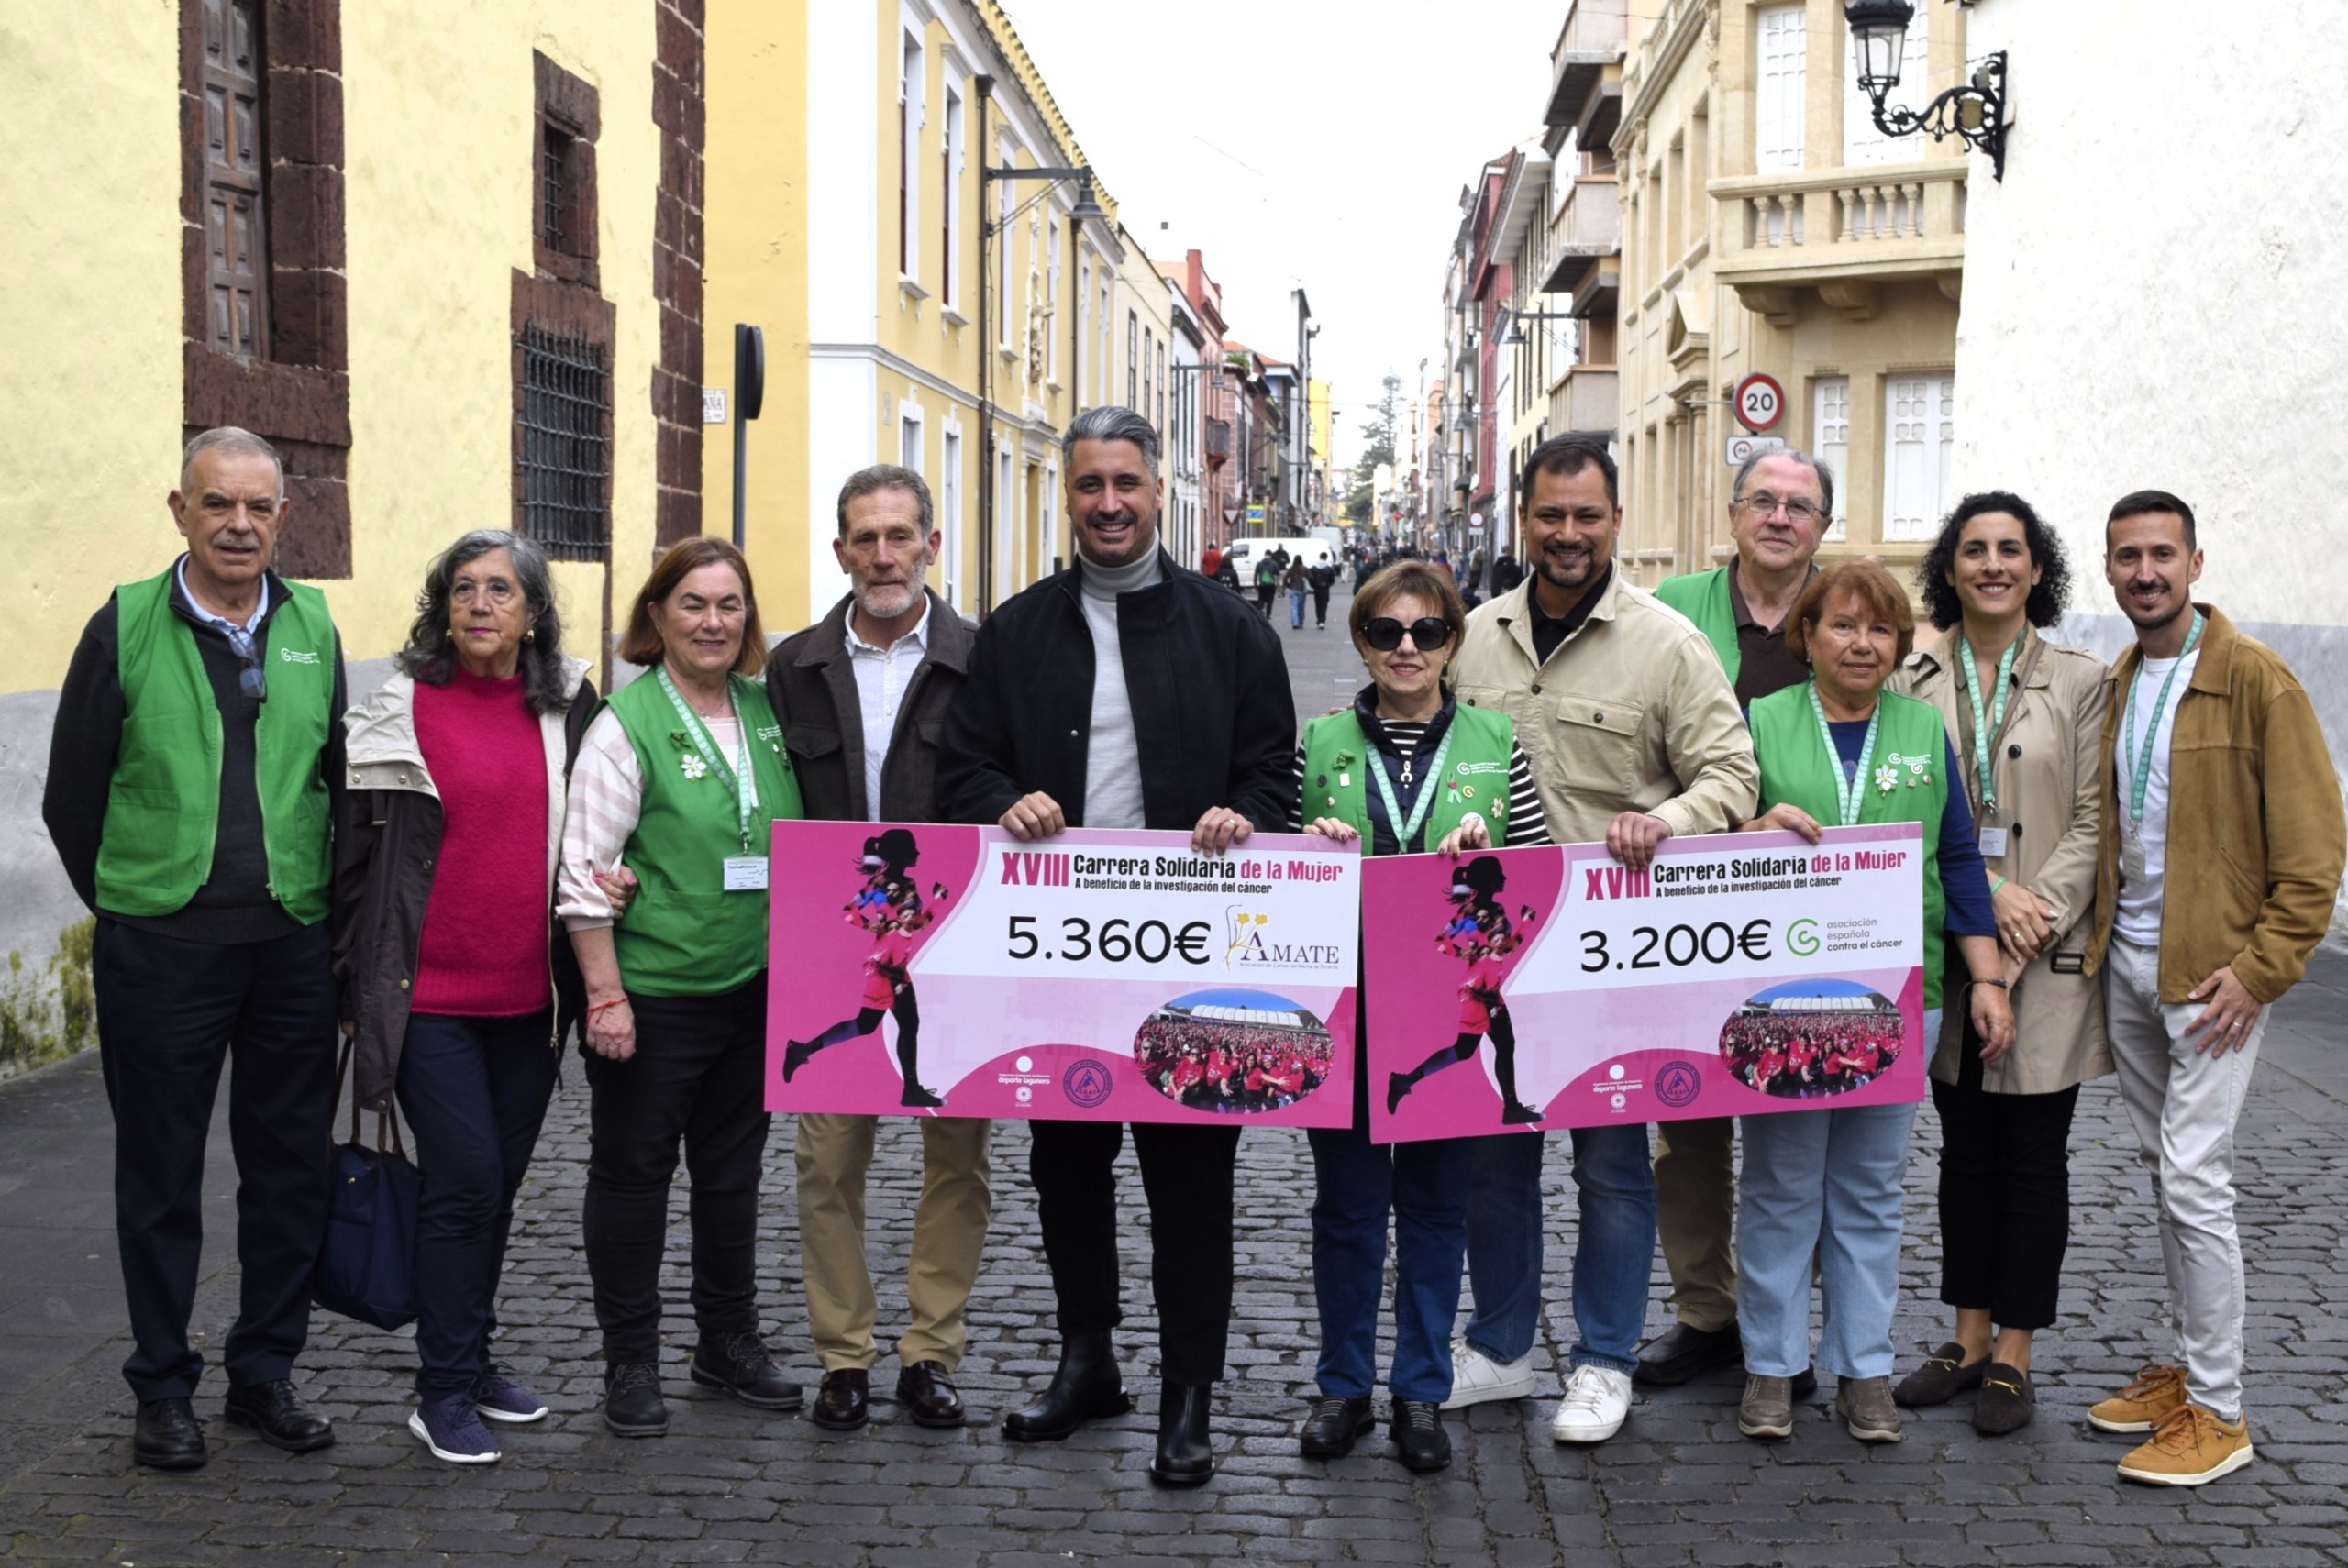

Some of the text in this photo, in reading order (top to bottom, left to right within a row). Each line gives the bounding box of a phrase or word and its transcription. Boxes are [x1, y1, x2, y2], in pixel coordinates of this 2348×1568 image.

[1746, 392, 1774, 411] 20
[1001, 852, 1344, 887] XVIII Carrera Solidaria de la Mujer
[1585, 849, 1907, 901] XVIII Carrera Solidaria de la Mujer
[1075, 878, 1273, 894] A beneficio de la investigación del cáncer
[1656, 875, 1842, 898] A beneficio de la investigación del cáncer
[1826, 917, 1877, 929] asociación
[1008, 915, 1212, 965] 5.360€
[1579, 919, 1772, 973] 3.200€
[1826, 929, 1871, 942] española
[1826, 938, 1903, 952] contra el cáncer
[1240, 931, 1339, 964] AMATE
[998, 1077, 1023, 1085] deporte
